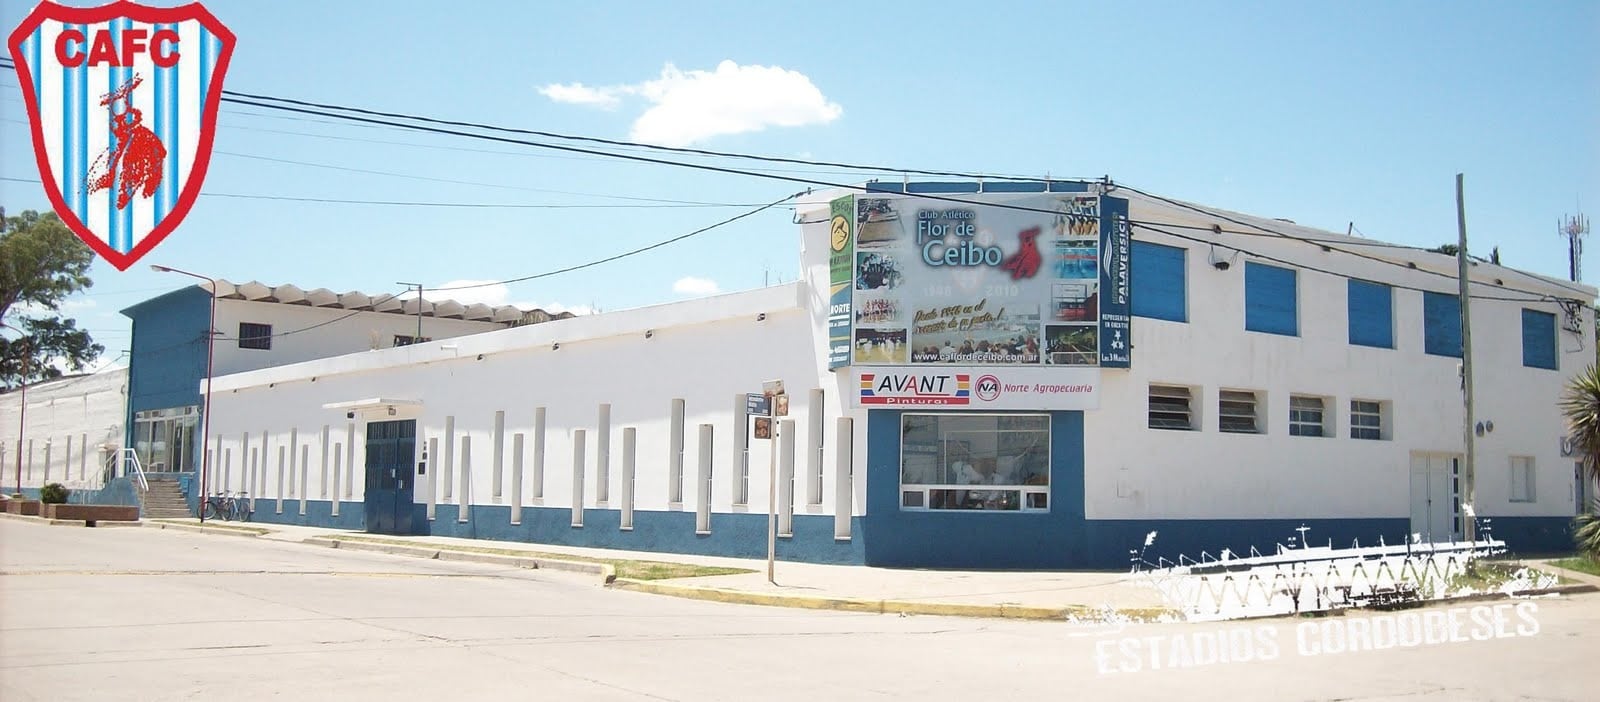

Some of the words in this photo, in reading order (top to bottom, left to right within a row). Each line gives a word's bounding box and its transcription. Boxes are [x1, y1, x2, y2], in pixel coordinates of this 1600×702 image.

[918, 209, 938, 219] Club
[941, 208, 975, 219] Atlético
[918, 220, 950, 245] Flor
[955, 221, 975, 236] de
[923, 240, 1002, 266] Ceibo
[878, 375, 950, 393] AVANT
[978, 383, 998, 392] NA
[1004, 383, 1029, 393] Norte
[1033, 383, 1093, 394] Agropecuaria
